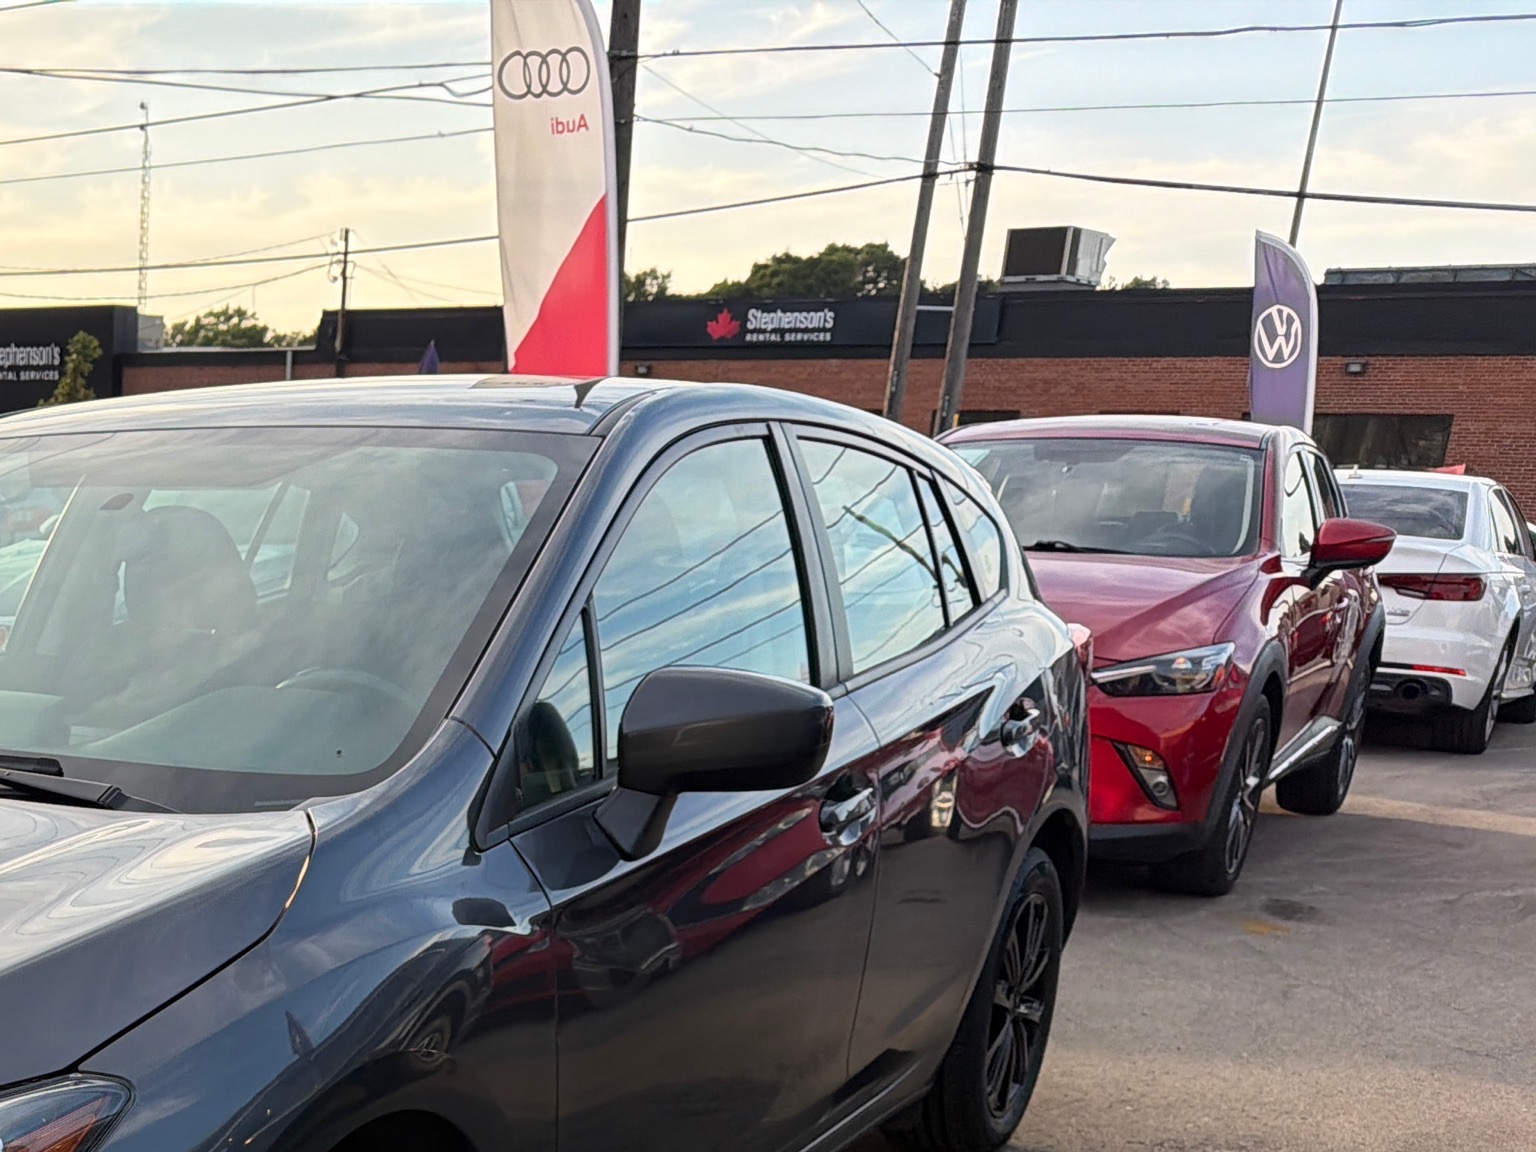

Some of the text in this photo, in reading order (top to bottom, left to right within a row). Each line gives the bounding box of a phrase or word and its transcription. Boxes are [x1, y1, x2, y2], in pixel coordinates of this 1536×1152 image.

[746, 308, 835, 331] Stephenson's
[745, 332, 832, 342] RENTAL SERVICES
[19, 370, 59, 381] SERVICES
